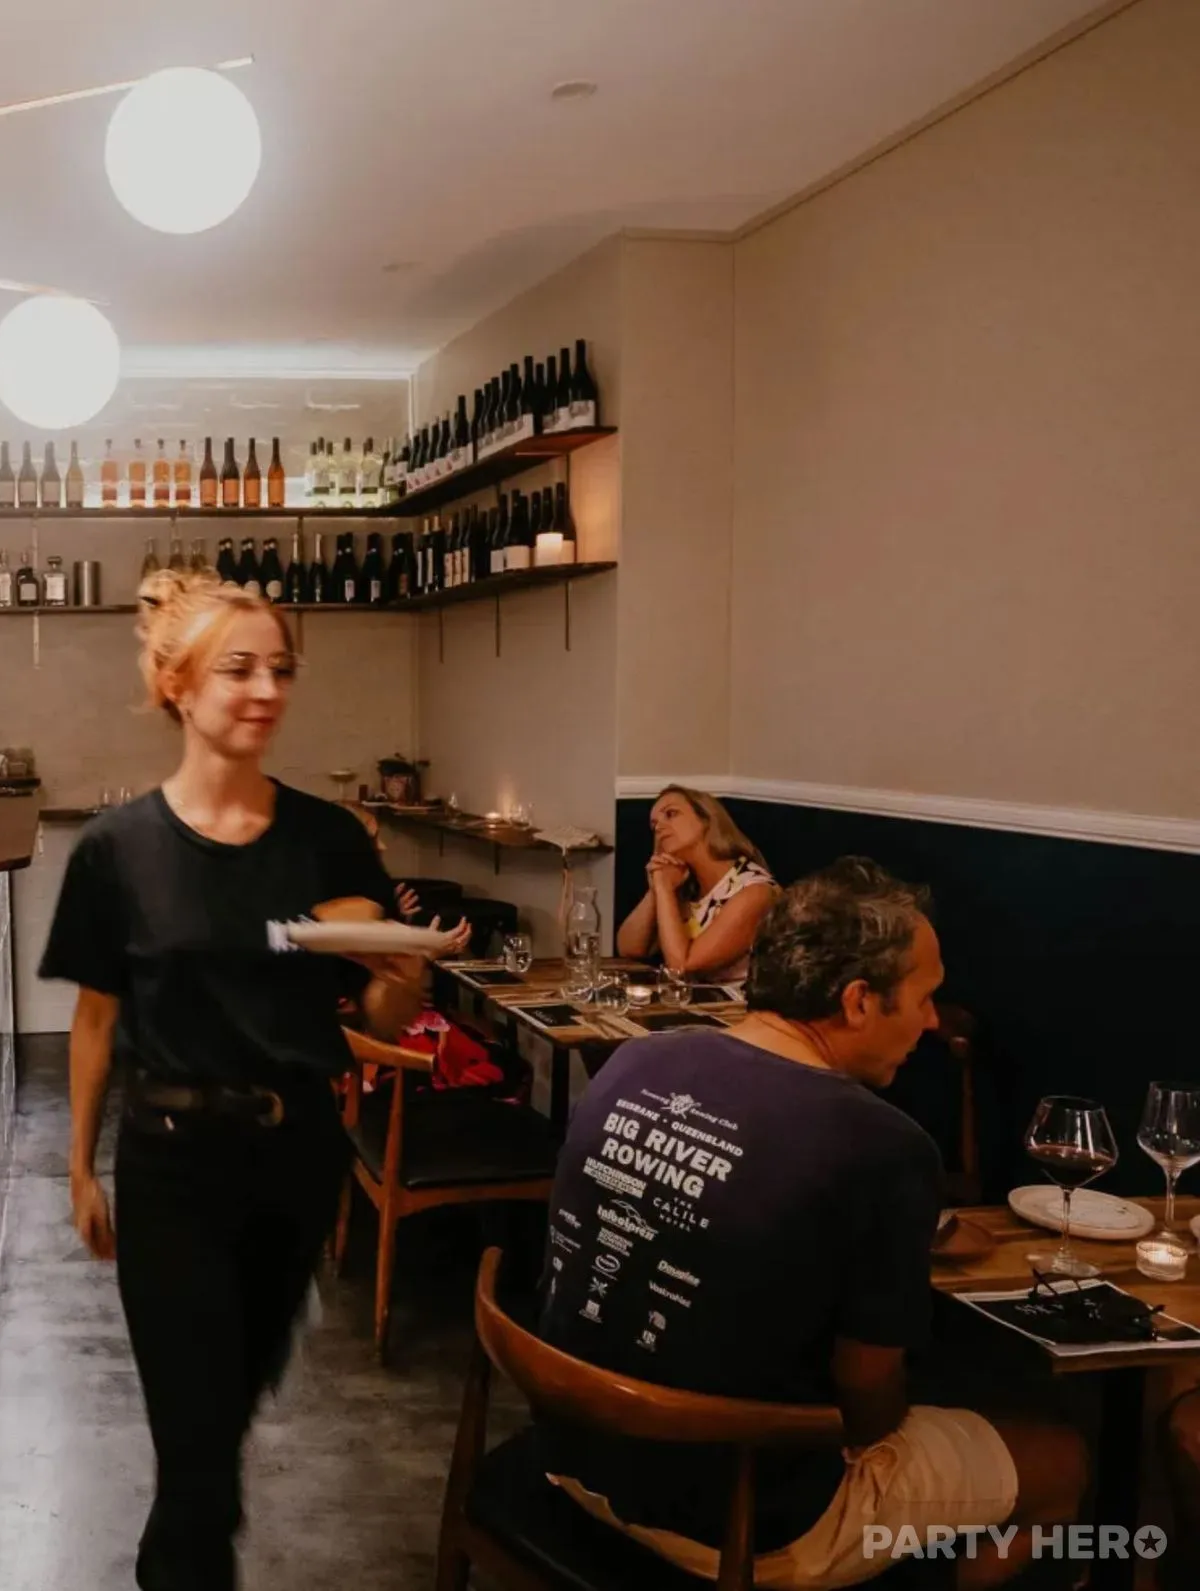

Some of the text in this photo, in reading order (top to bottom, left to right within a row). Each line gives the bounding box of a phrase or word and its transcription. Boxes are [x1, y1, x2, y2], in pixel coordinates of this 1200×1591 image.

[603, 1111, 733, 1182] BIG RIVER
[616, 1098, 744, 1157] BRISBANE QUEENSLAND
[717, 1117, 739, 1131] Club
[585, 1156, 647, 1191] HUTCHINSON
[601, 1137, 705, 1198] ROWING
